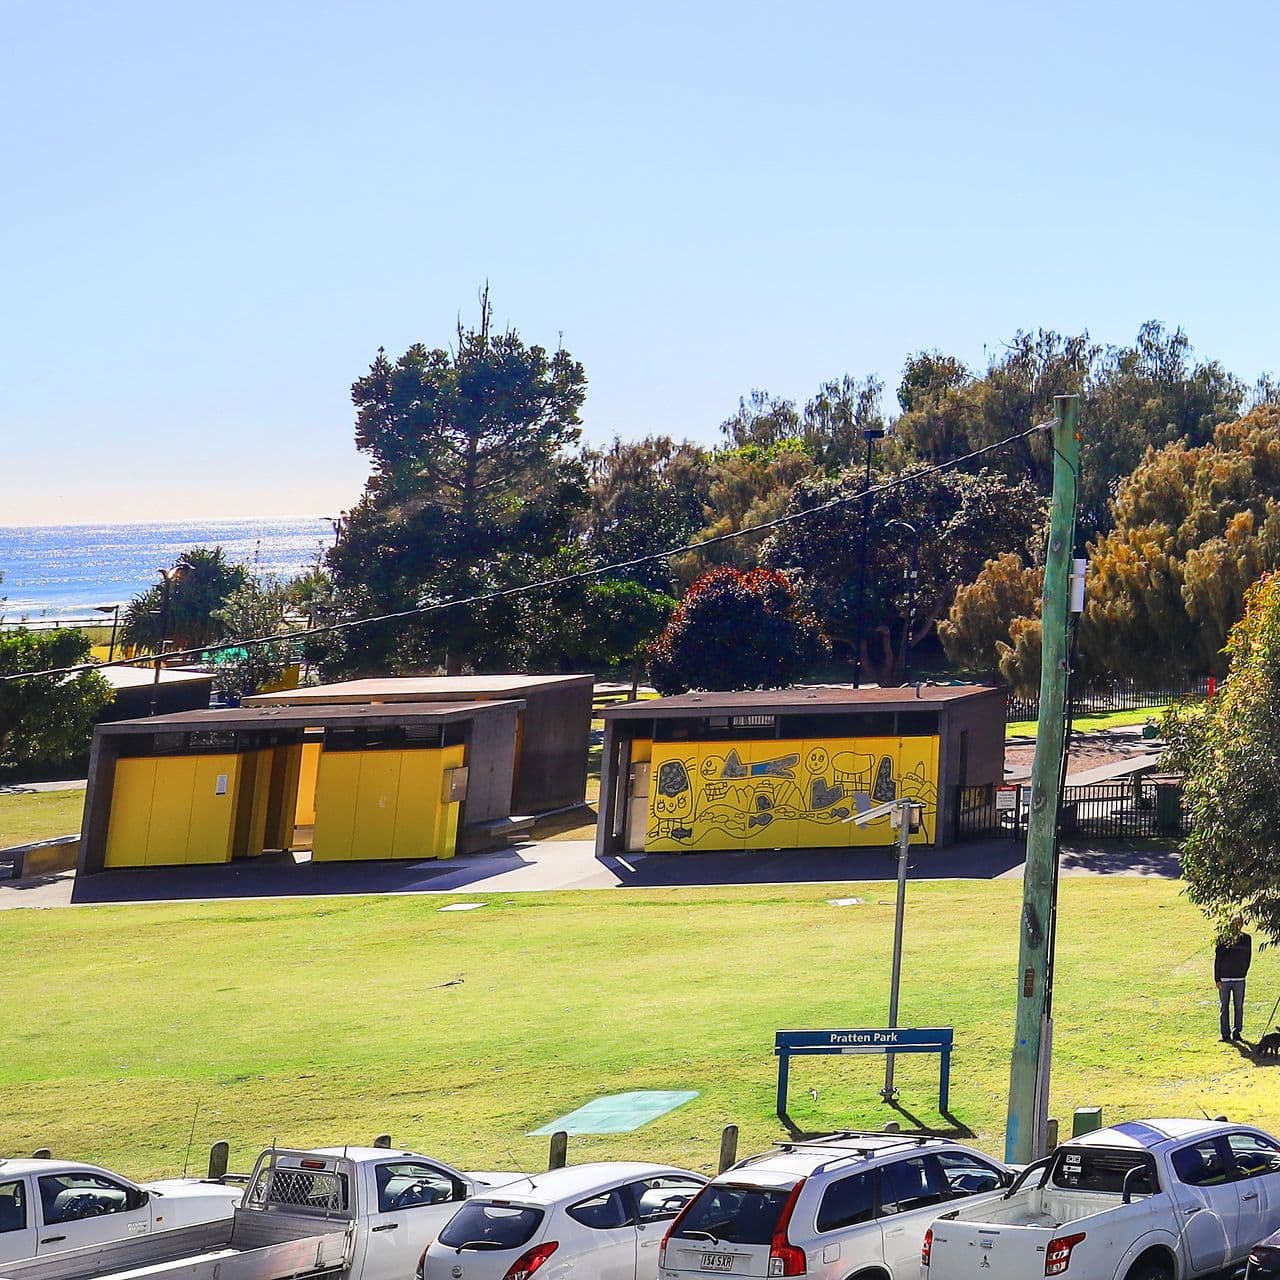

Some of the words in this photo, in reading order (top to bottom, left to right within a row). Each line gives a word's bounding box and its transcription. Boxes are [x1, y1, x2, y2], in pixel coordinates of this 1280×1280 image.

[830, 1033, 871, 1043] Pratten
[873, 1032, 898, 1042] Park
[716, 1255, 732, 1267] SXR
